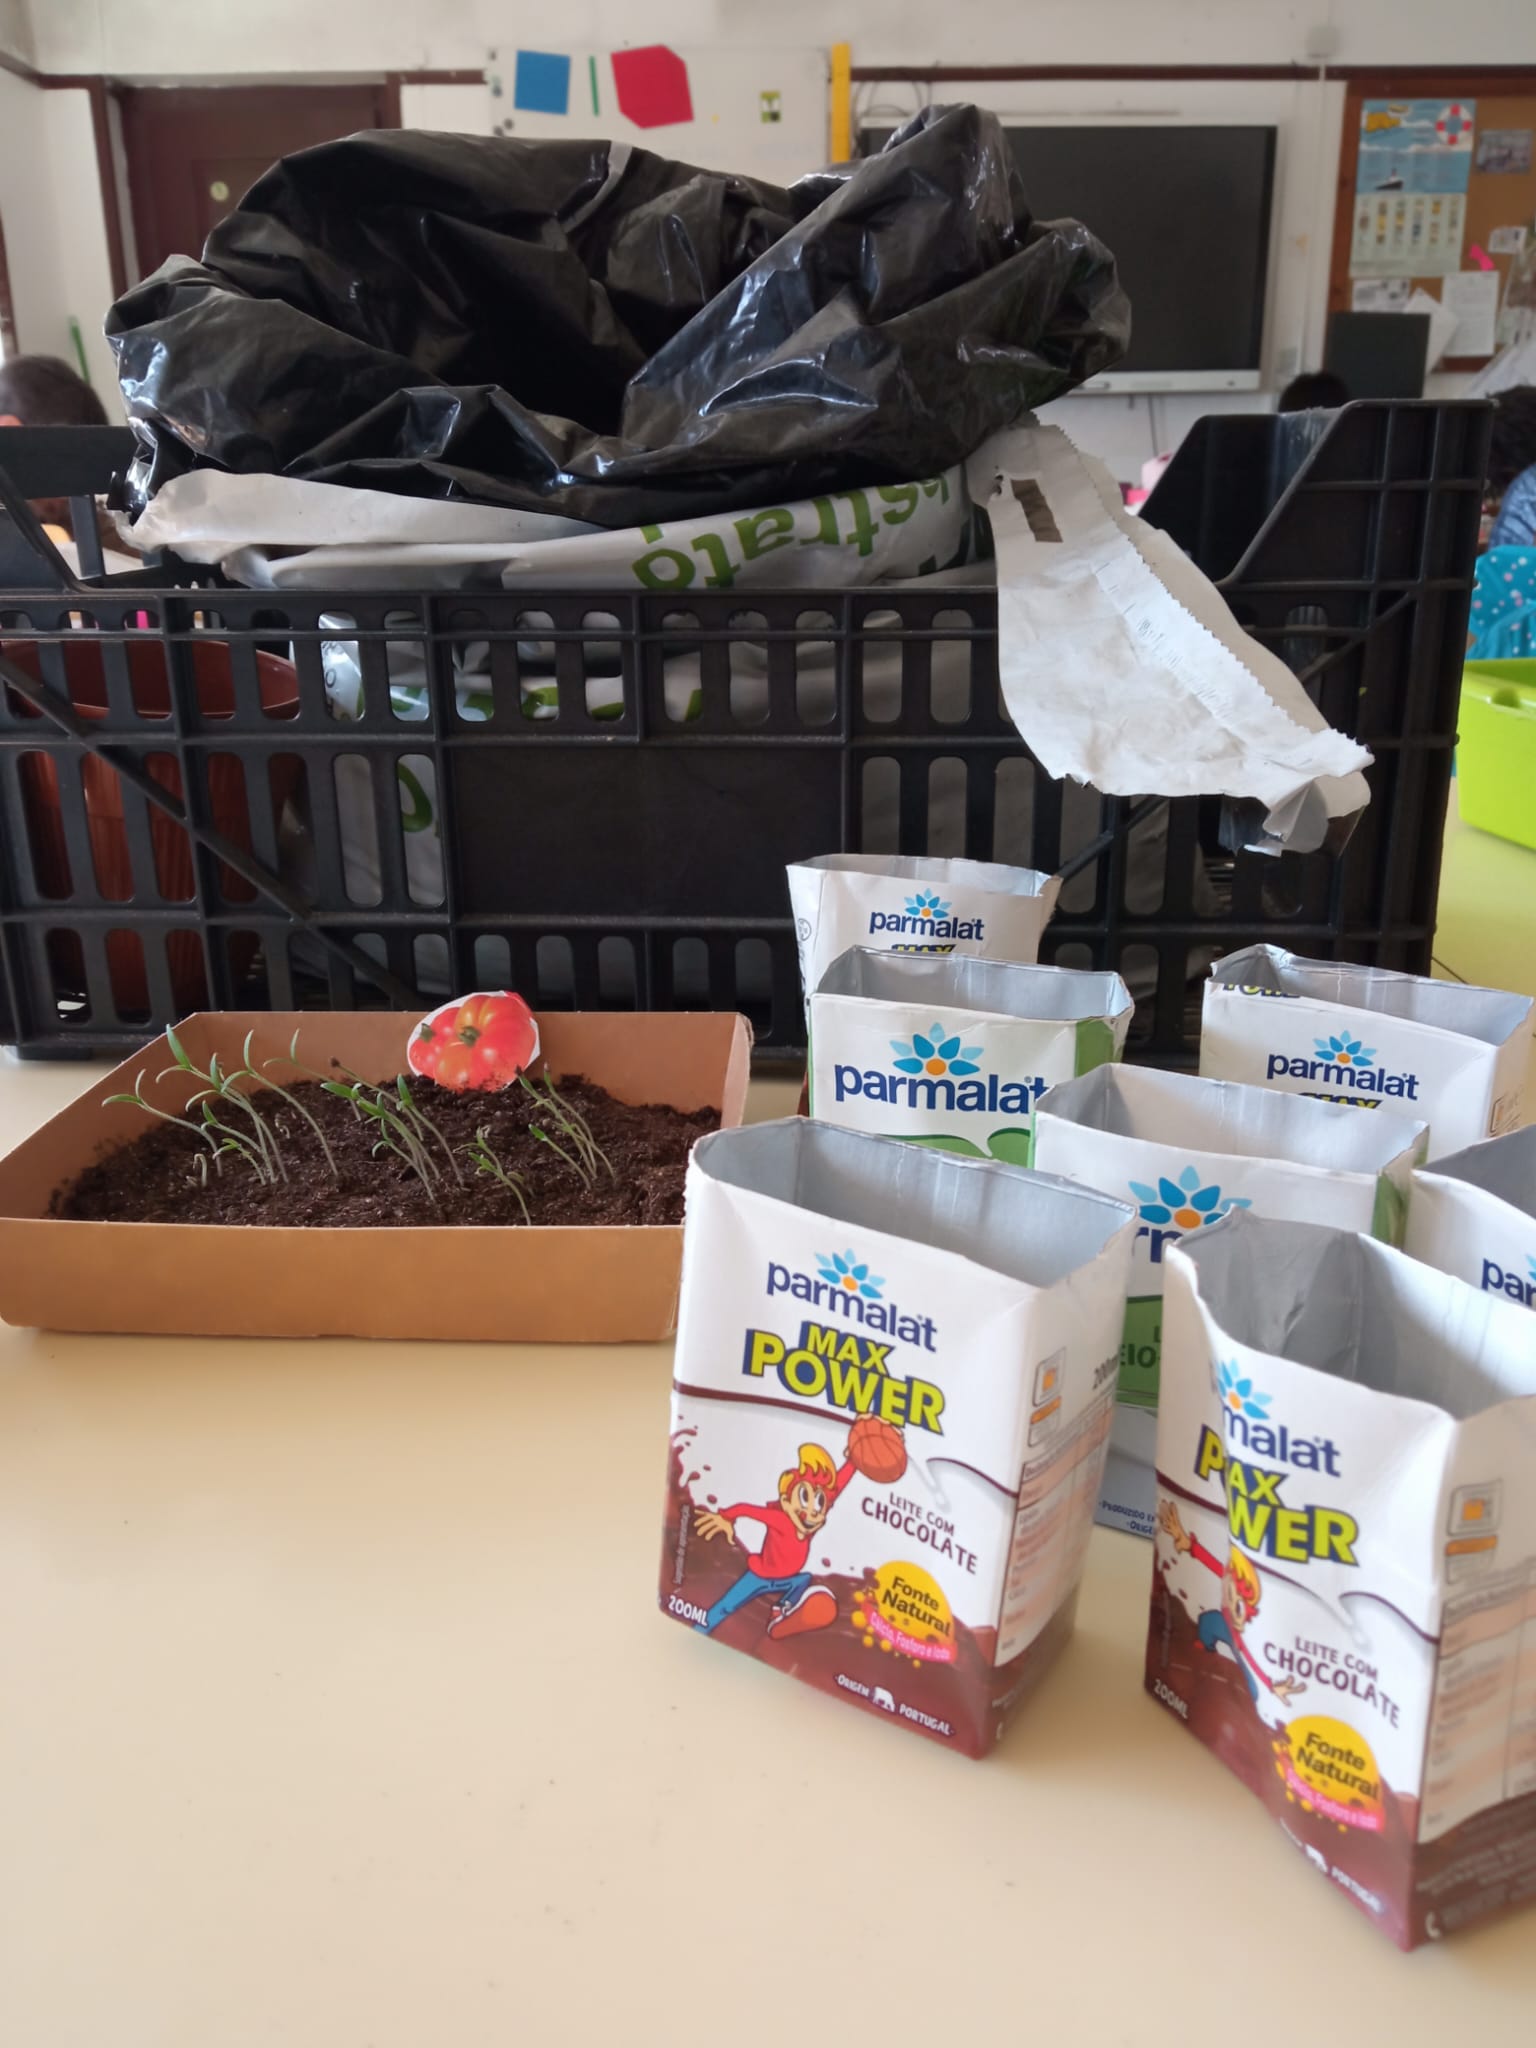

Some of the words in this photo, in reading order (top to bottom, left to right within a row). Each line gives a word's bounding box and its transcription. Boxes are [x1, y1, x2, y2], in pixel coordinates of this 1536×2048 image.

[868, 911, 985, 941] parmalat
[1266, 1054, 1420, 1101] parmalat
[766, 1261, 938, 1353] parmalat
[798, 1321, 897, 1378] MAX
[742, 1328, 946, 1437] POWER
[1223, 1404, 1341, 1478] malat
[1229, 1456, 1289, 1509] AX
[861, 1497, 978, 1575] CHOCOLATE
[889, 1492, 923, 1520] LEITE
[926, 1511, 955, 1537] COM
[668, 1595, 709, 1627] 200ML
[881, 1589, 952, 1638] Natural
[891, 1575, 940, 1612] Fonte
[1295, 1636, 1339, 1664] LEITE
[1344, 1653, 1379, 1681] COM
[1153, 1679, 1188, 1720] 200ML
[1263, 1642, 1400, 1729] CHOCOLATE
[899, 1703, 951, 1736] PORTUGAL
[1296, 1747, 1380, 1800] Natural
[1305, 1731, 1366, 1771] Fonte
